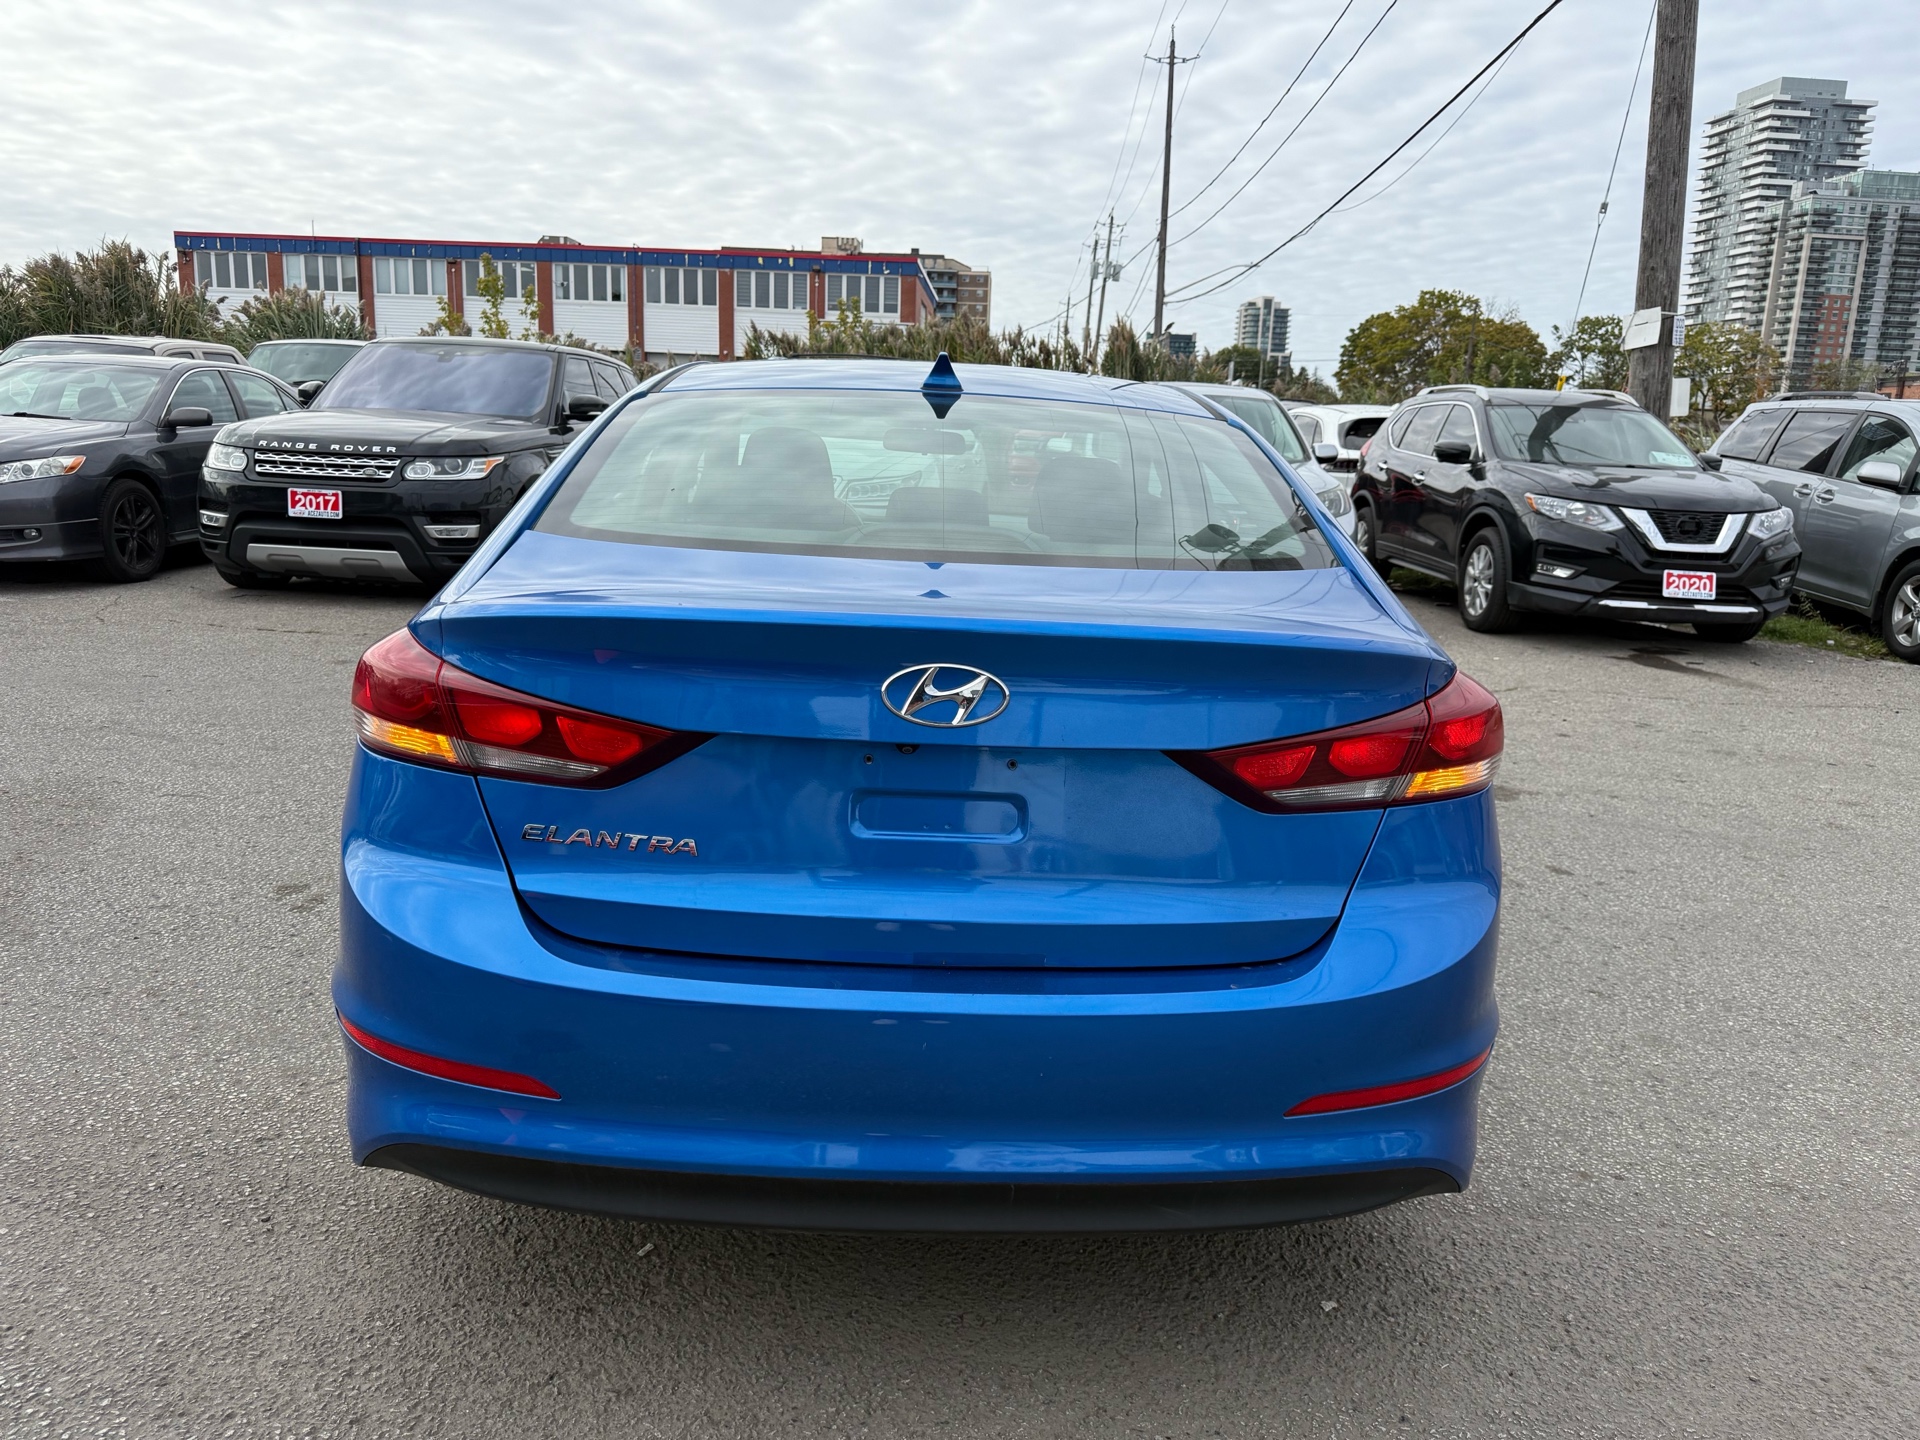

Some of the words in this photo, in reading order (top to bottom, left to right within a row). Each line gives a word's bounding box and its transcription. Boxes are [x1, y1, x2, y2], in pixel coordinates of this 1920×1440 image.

[258, 440, 318, 450] RANGE
[330, 444, 397, 453] ROVER
[294, 494, 336, 511] 2017
[1668, 576, 1710, 592] 2020
[520, 823, 698, 857] ELANTRA
